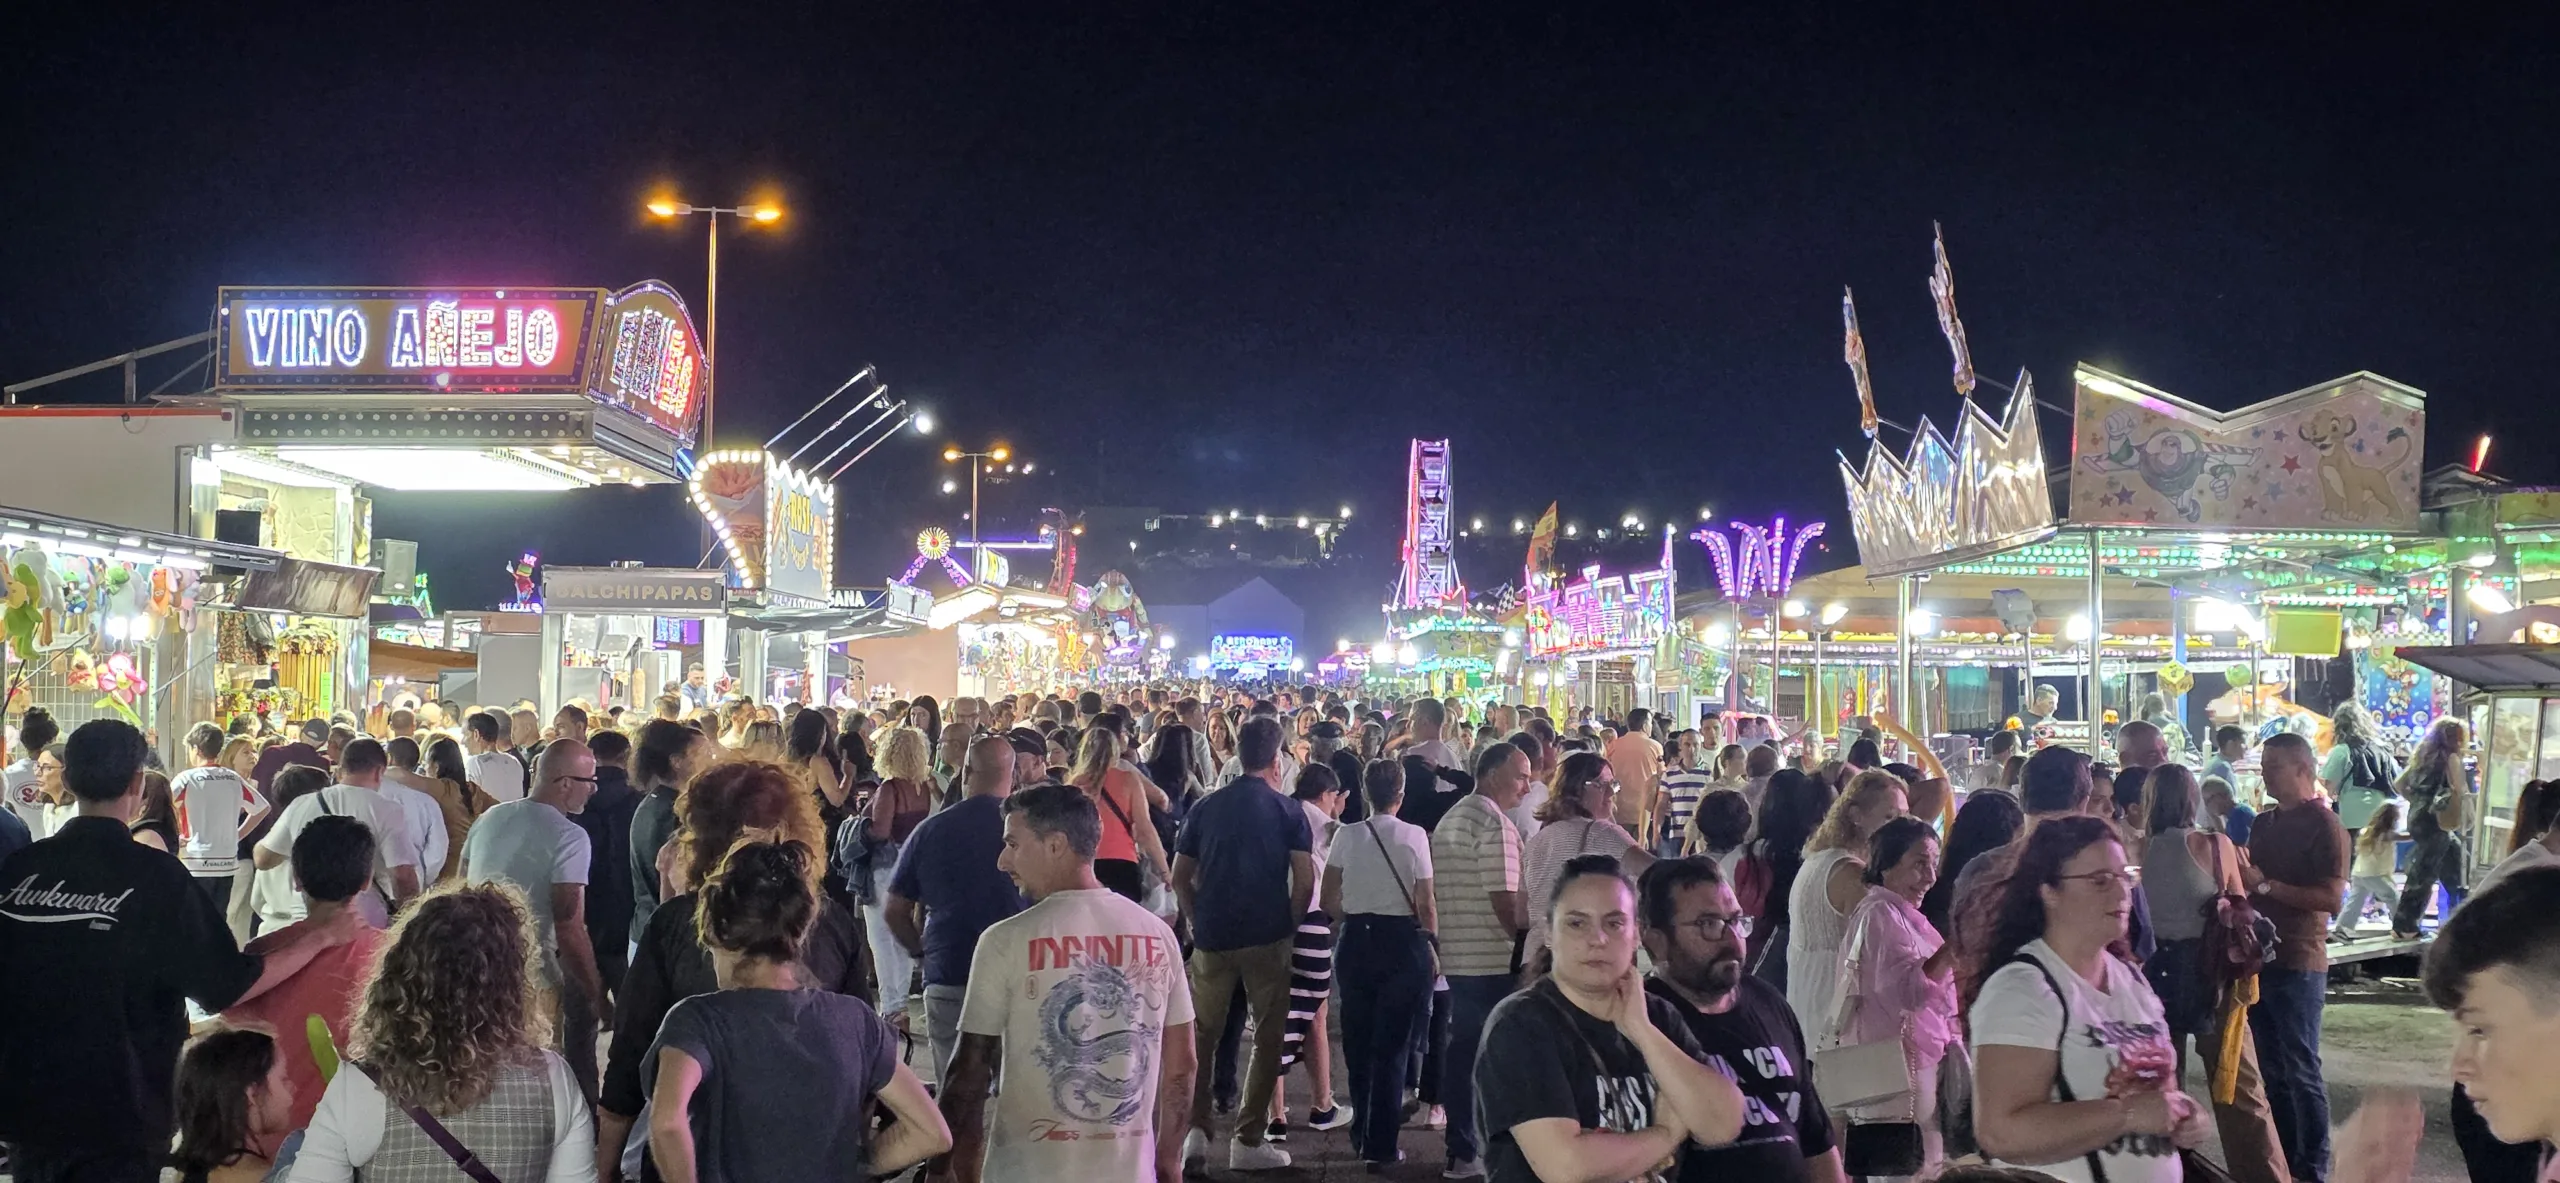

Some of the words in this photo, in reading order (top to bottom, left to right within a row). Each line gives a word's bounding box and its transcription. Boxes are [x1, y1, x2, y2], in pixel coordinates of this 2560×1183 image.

[246, 307, 368, 367] VINO
[391, 300, 559, 367] AÑEJO
[1, 873, 135, 913] Awkward
